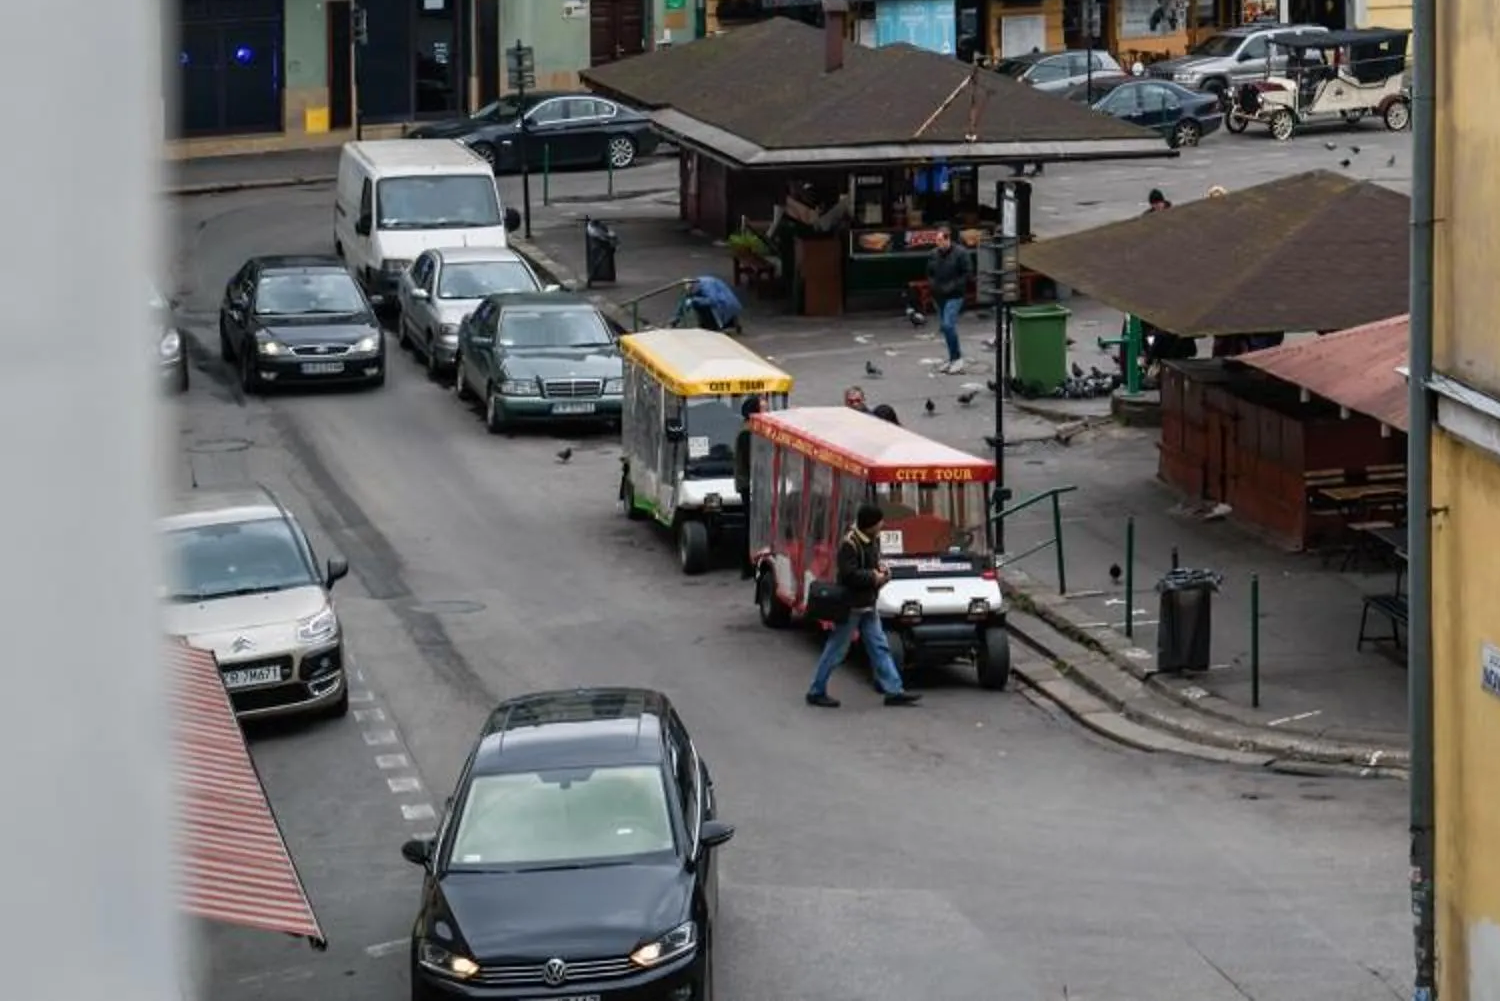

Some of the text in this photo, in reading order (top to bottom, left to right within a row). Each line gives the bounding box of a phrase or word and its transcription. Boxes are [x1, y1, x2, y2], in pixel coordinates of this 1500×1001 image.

[709, 380, 765, 391] CITY TOUR
[895, 466, 973, 481] CITY TOUR
